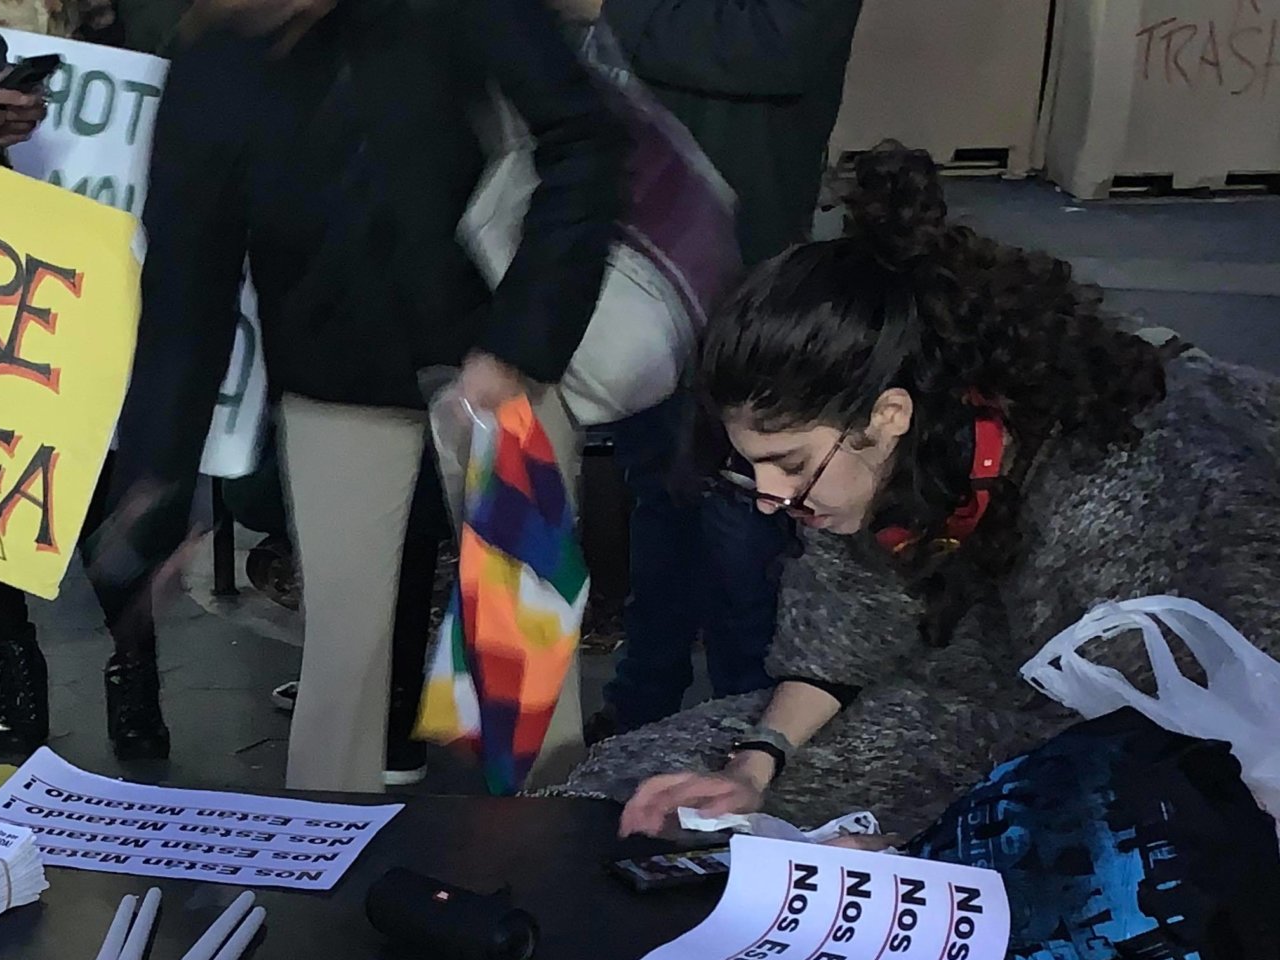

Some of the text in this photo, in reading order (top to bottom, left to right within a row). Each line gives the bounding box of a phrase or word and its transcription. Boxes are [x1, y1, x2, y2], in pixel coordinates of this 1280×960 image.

[44, 788, 186, 816] Matando
[24, 806, 169, 832] Matando
[196, 808, 293, 827] Están
[304, 820, 372, 832] Nos
[178, 823, 277, 842] Están
[288, 835, 356, 848] Nos
[160, 839, 261, 858] Están
[271, 851, 340, 864] Nos
[141, 856, 243, 876] Están
[254, 868, 324, 882] Nos
[776, 863, 819, 933] Nos
[831, 869, 872, 943] Nos
[889, 877, 927, 953] Nos
